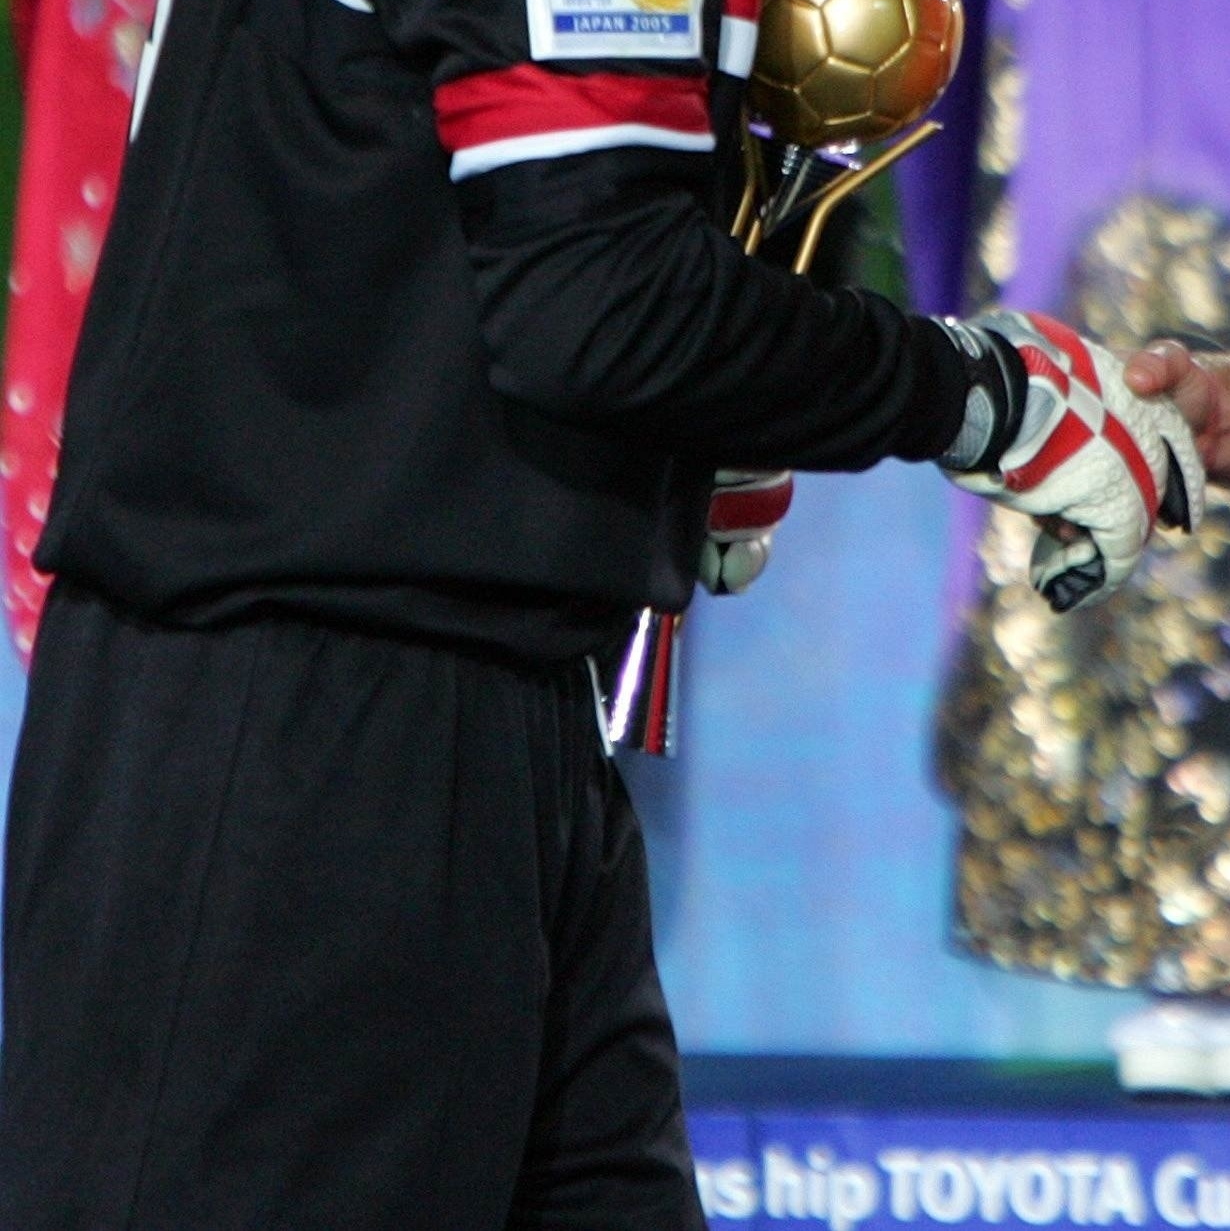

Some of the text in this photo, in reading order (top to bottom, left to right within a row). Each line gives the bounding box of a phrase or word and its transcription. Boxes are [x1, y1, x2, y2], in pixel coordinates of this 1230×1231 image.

[574, 15, 672, 32] JAPAN 2005
[877, 1148, 1146, 1226] TOYOTA
